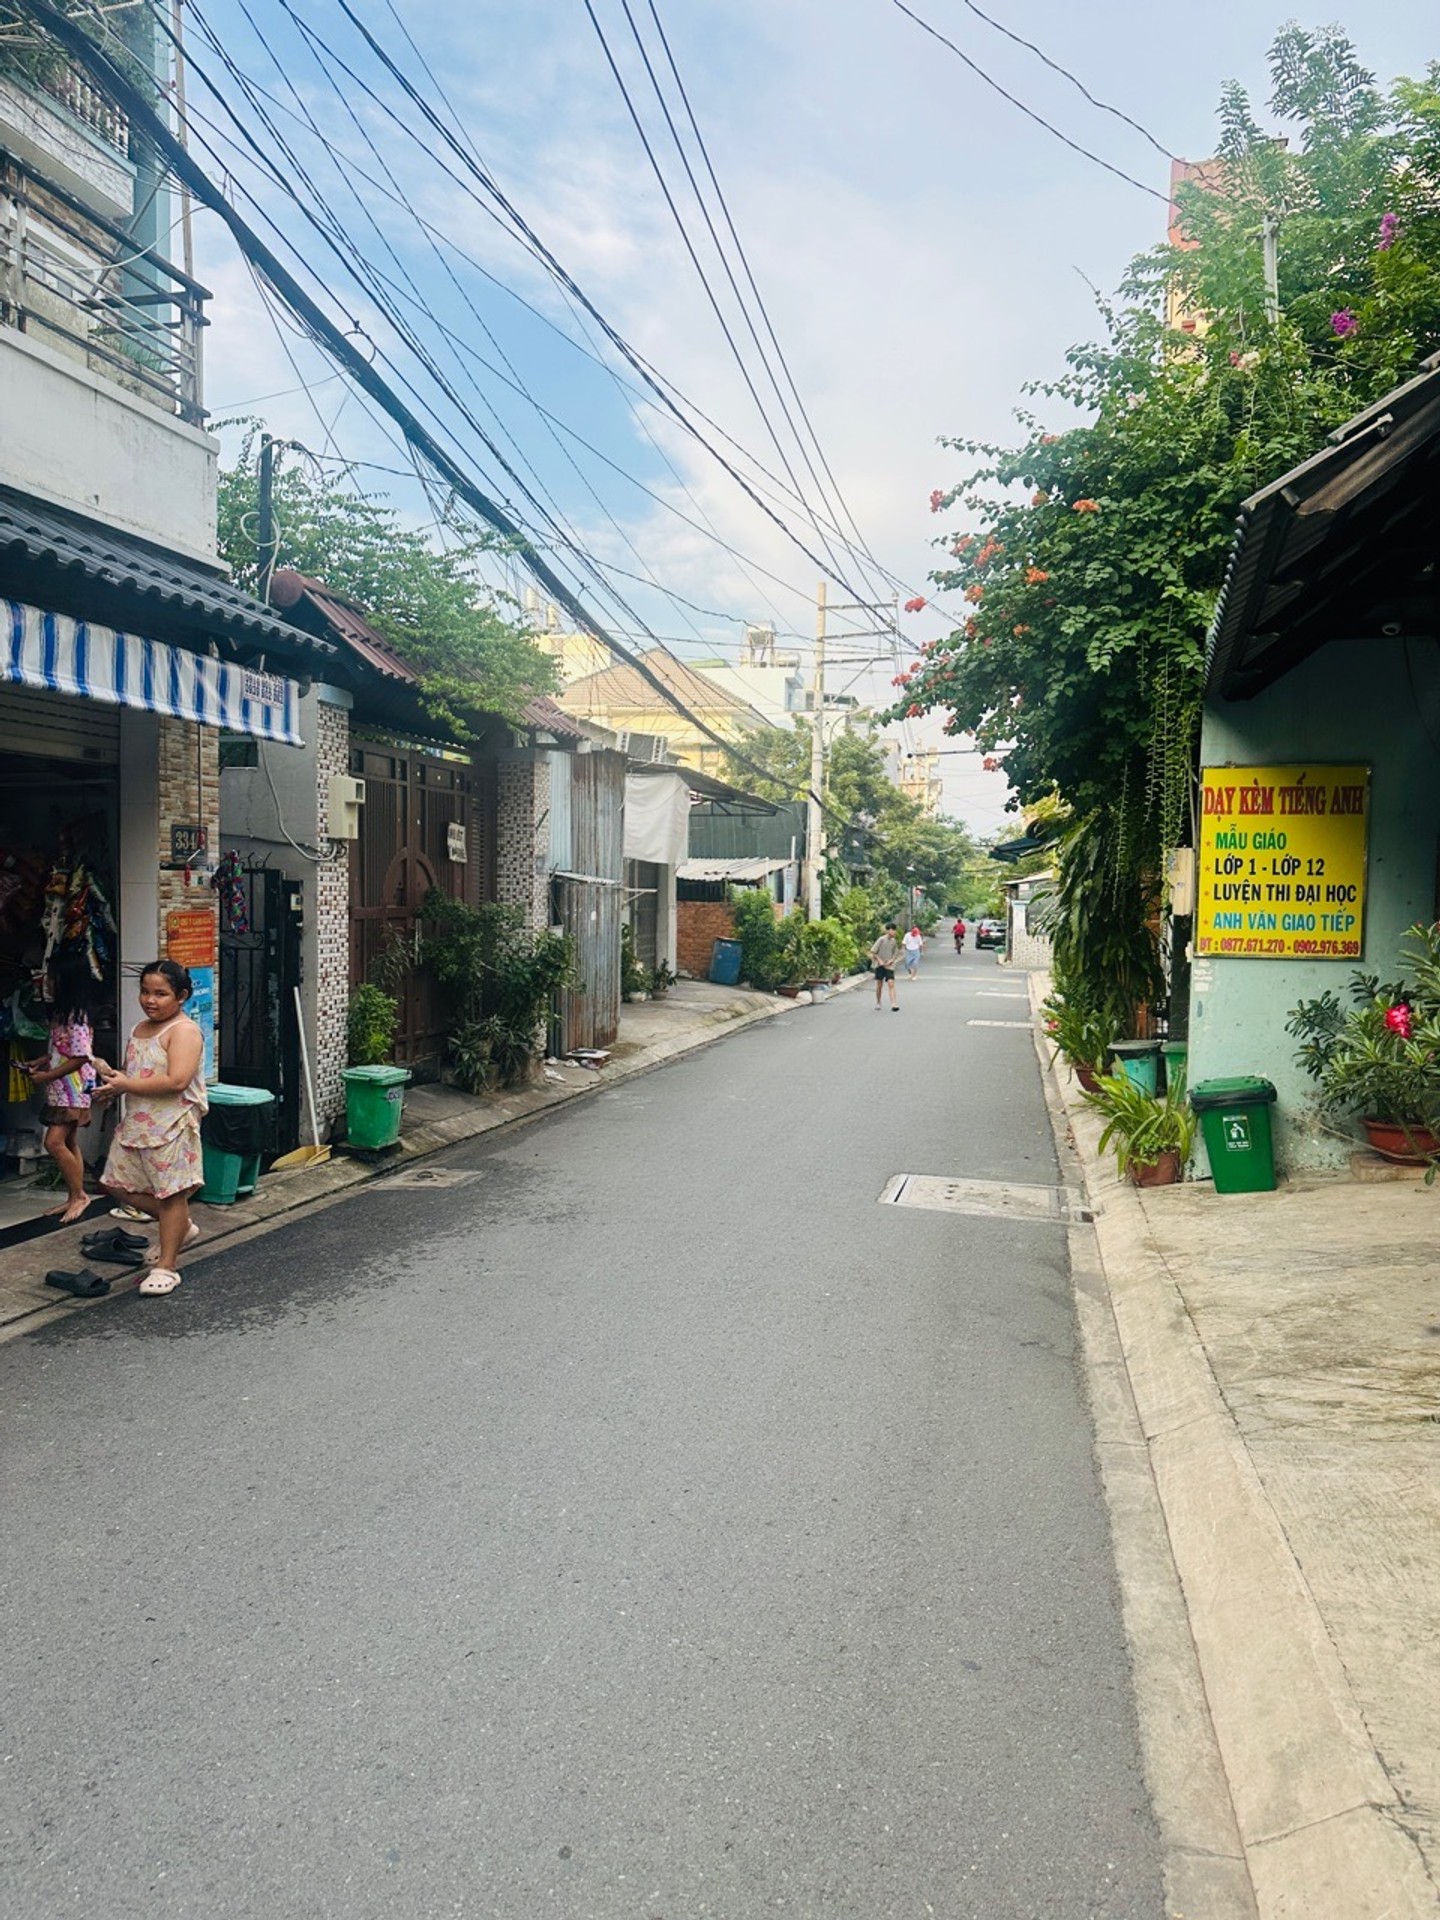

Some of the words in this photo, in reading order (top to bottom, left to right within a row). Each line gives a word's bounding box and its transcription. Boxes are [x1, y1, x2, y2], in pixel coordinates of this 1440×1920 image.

[1203, 786, 1236, 822] DẠY
[1238, 778, 1275, 815] KÈM
[1278, 772, 1327, 815] TIẾNG
[1329, 786, 1365, 815] ANH
[1215, 824, 1248, 849] MẪU
[1252, 828, 1287, 850] GIÁO
[1215, 854, 1244, 875] LỚP
[1249, 858, 1257, 875] 1
[1272, 854, 1301, 876] LỚP
[1306, 858, 1325, 876] 12
[1213, 880, 1261, 904] LUYỆN
[1266, 884, 1290, 901] THI
[1295, 884, 1320, 906] ĐẠI
[1326, 885, 1357, 906] HỌC
[1213, 912, 1243, 929] ANH
[1248, 909, 1277, 930] VĂN
[1282, 914, 1316, 931] GIAO
[1321, 908, 1355, 932] TIẾP
